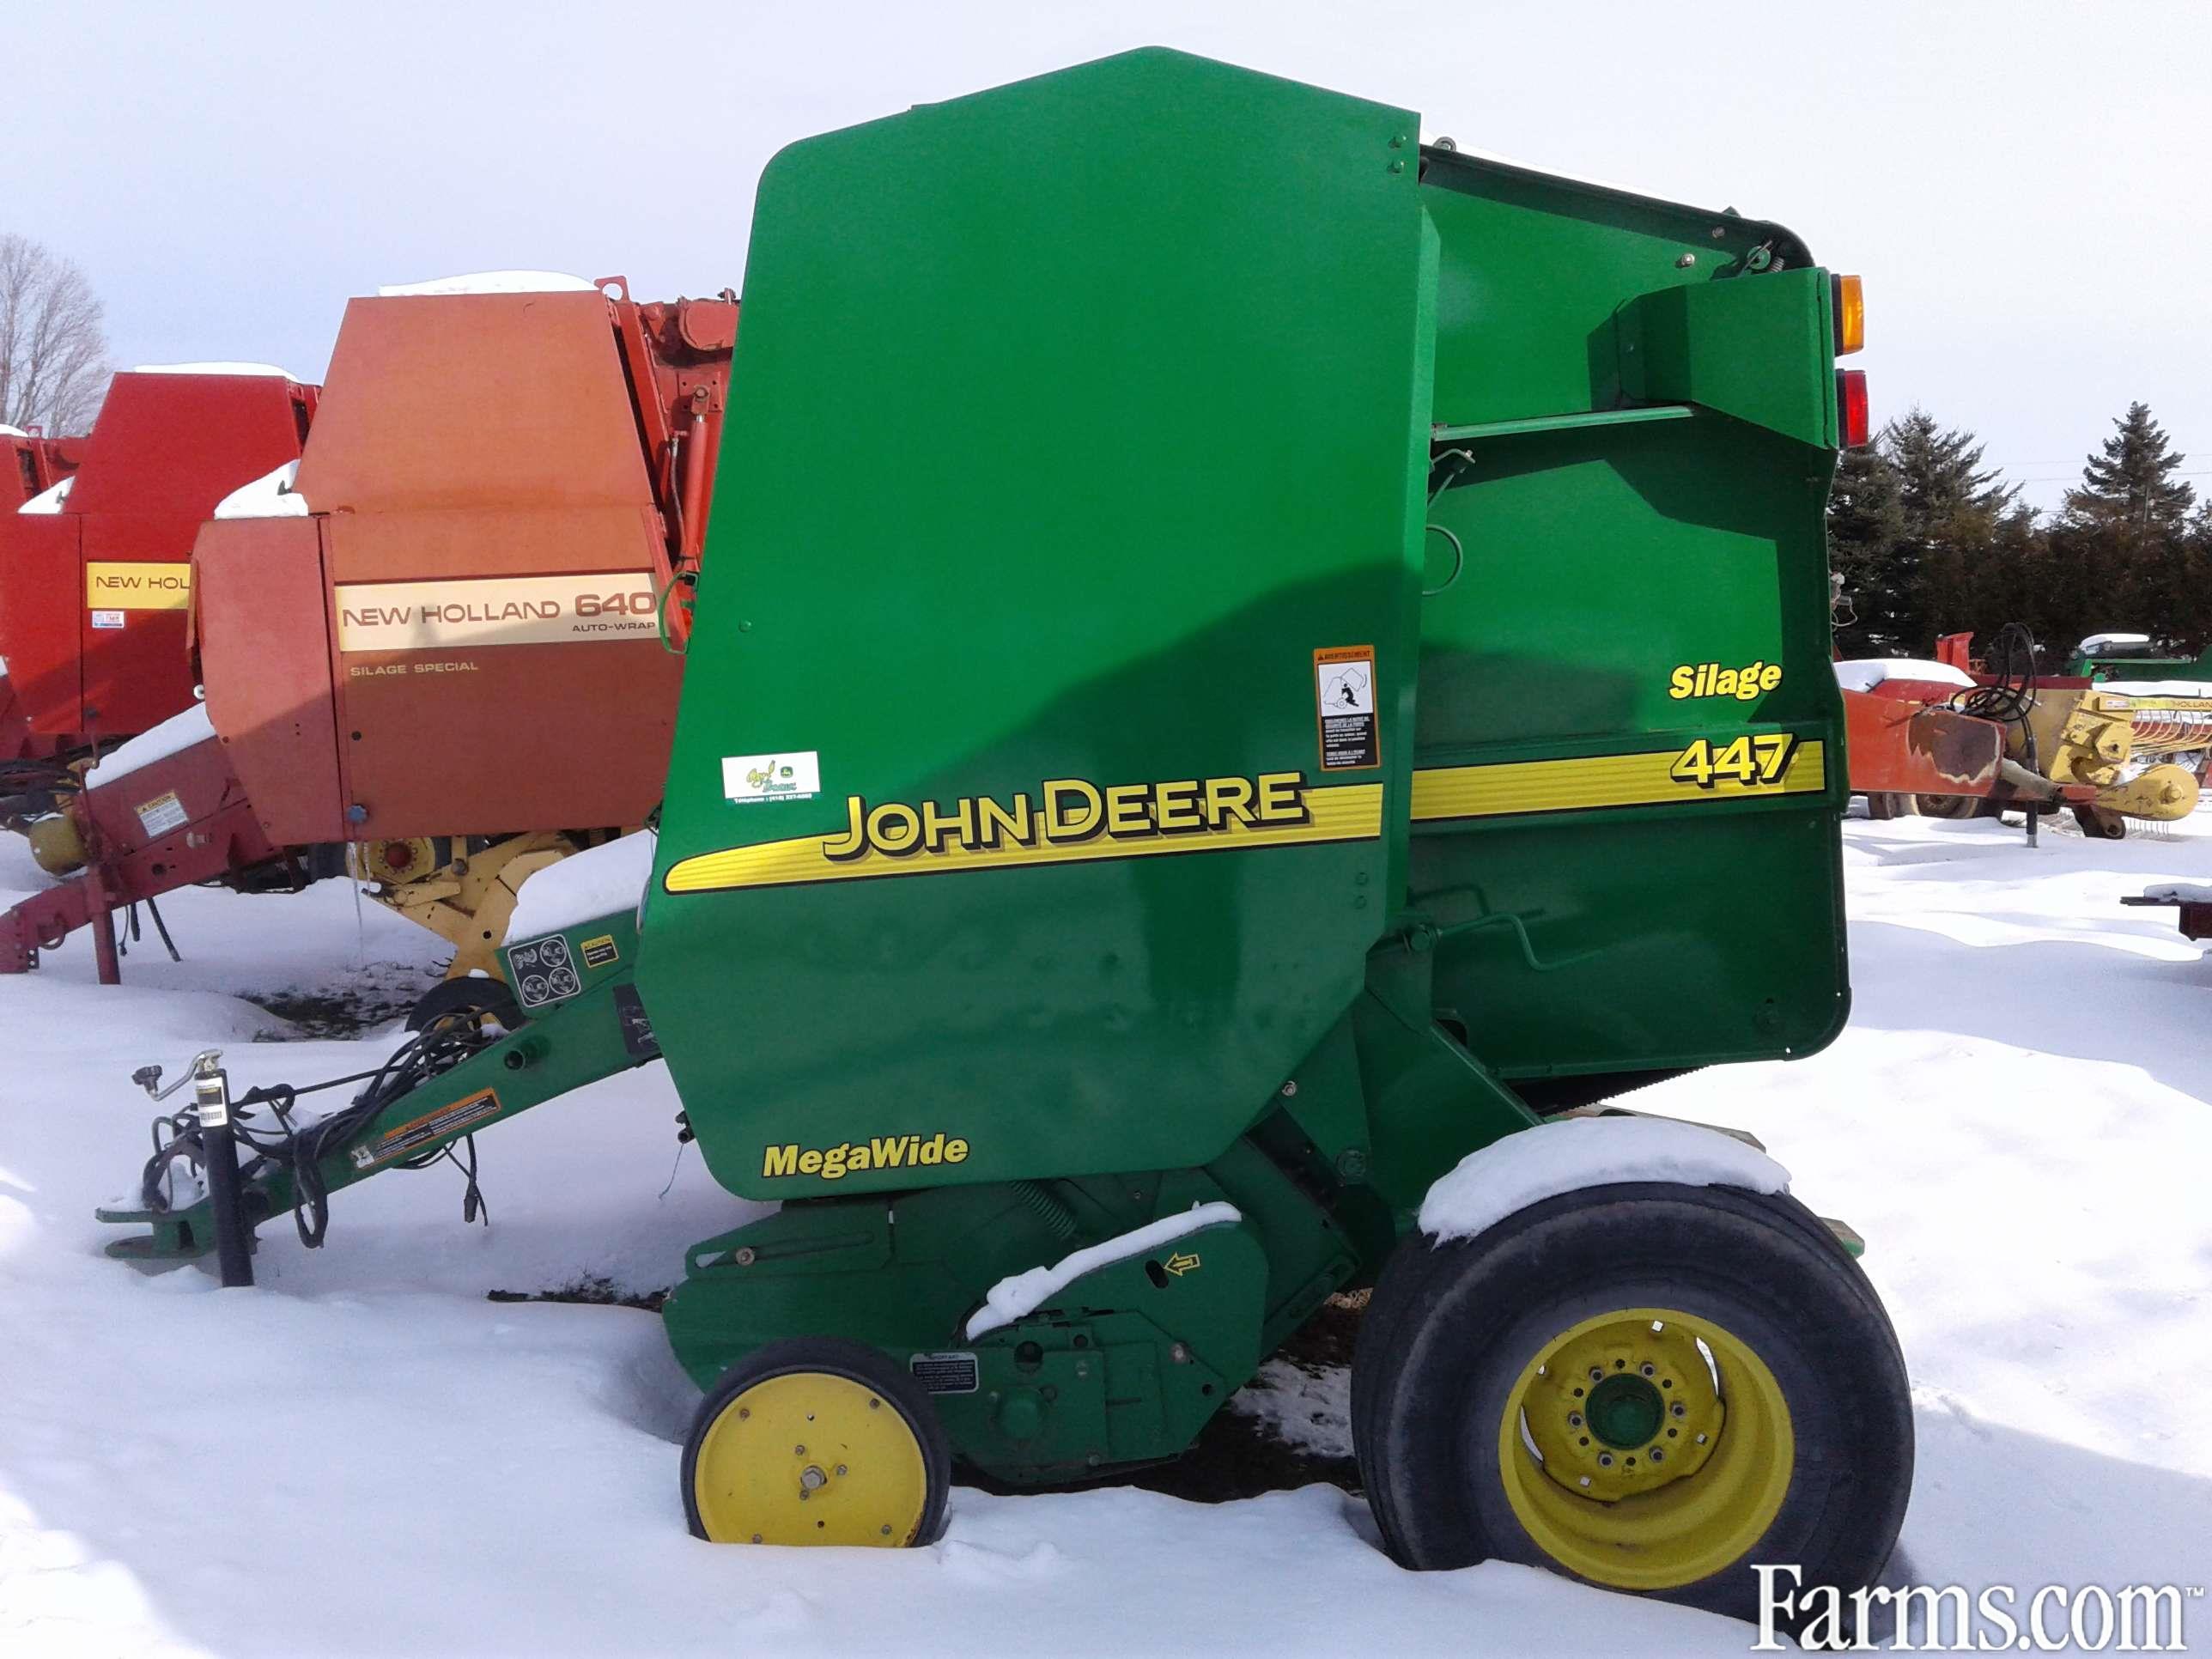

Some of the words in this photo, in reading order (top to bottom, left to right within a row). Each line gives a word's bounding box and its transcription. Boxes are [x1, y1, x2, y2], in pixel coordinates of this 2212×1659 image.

[95, 576, 142, 589] NEW
[148, 577, 191, 590] HOL
[343, 606, 411, 627] NEW
[421, 600, 561, 624] HOLLAND
[574, 591, 657, 618] 640
[571, 621, 656, 634] AUTO-WRAP
[349, 664, 407, 677] SILAGE
[414, 661, 479, 674] SPECIAL
[1668, 659, 1784, 700] Silage
[1669, 732, 1797, 787] 447
[822, 793, 1034, 860] JOHN
[1042, 771, 1307, 845] DEERE
[762, 1132, 969, 1181] MegaWide
